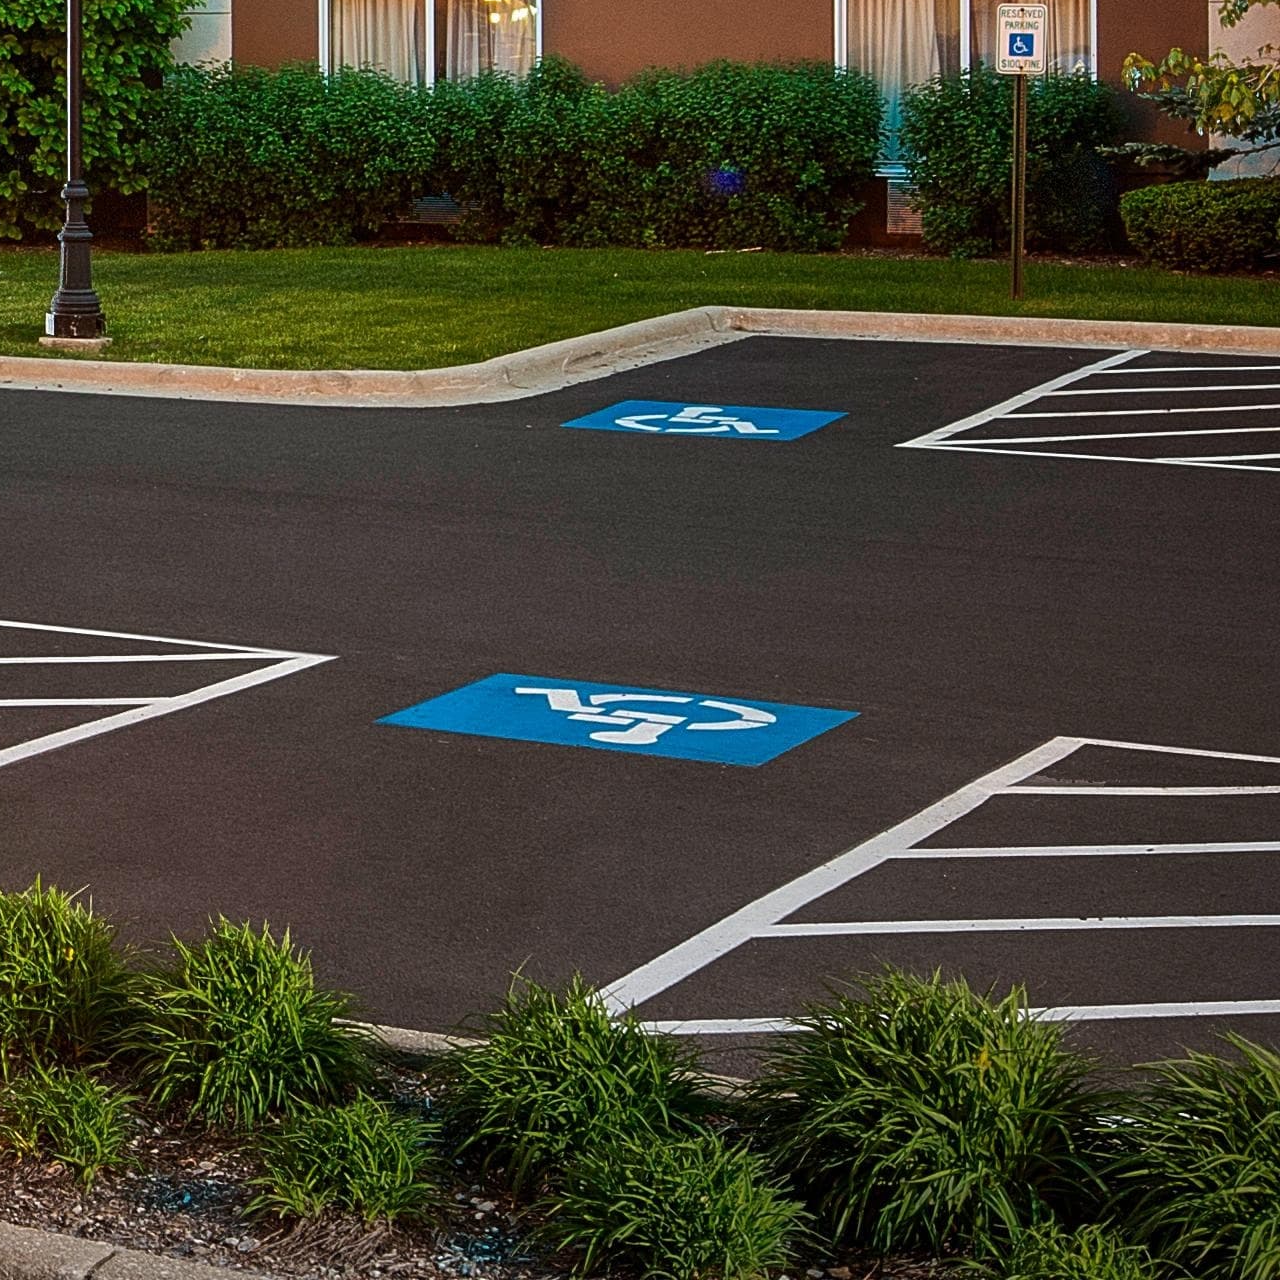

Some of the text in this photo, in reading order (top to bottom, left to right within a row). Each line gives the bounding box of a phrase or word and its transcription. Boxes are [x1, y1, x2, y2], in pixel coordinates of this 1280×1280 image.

[1000, 8, 1044, 19] RESERVED
[1004, 20, 1040, 30] PARKING
[1023, 58, 1041, 69] FINE
